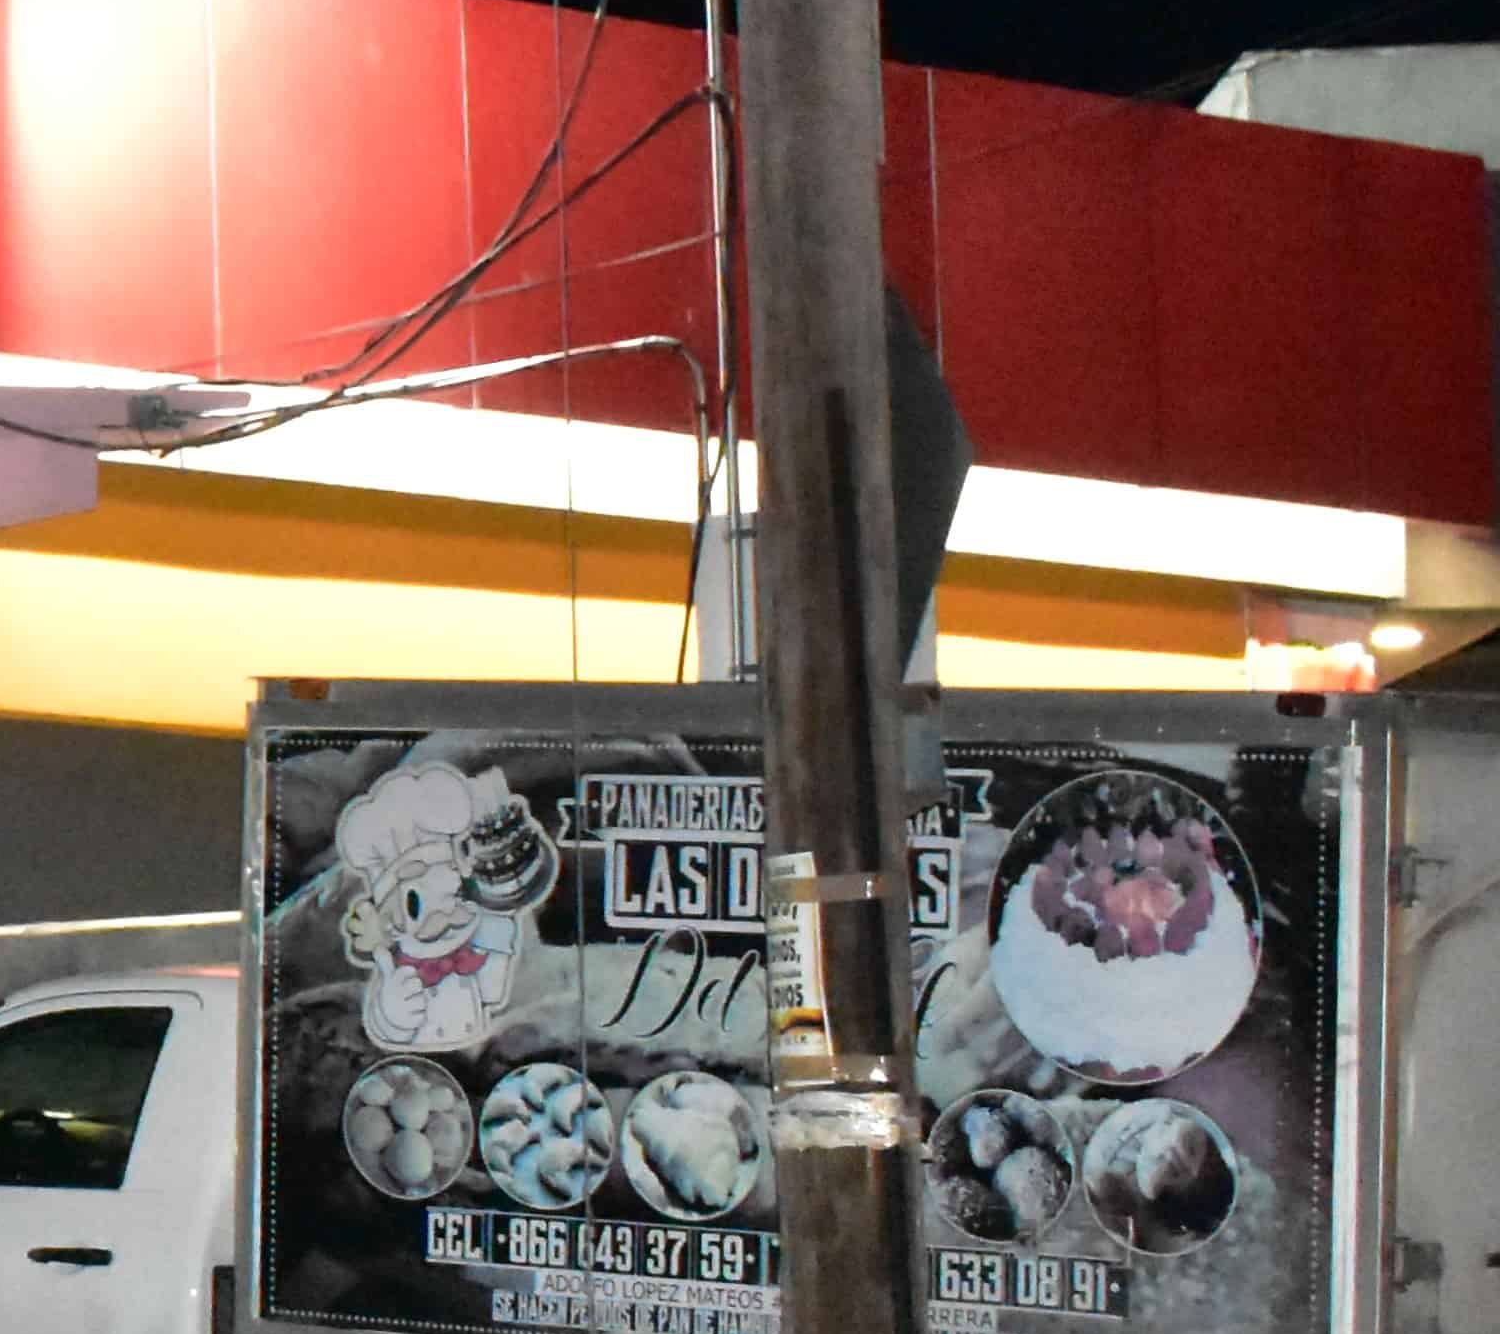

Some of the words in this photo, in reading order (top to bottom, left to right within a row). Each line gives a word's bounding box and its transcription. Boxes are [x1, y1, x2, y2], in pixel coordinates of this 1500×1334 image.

[617, 842, 708, 917] LAS
[426, 1212, 484, 1260] CEL
[508, 1218, 568, 1267] 866
[646, 1227, 688, 1276] 37
[700, 1233, 745, 1281] 59
[939, 1250, 1003, 1303] 633
[1016, 1257, 1063, 1307] 08
[1071, 1260, 1108, 1312] 91
[622, 1280, 680, 1303] LOPEZ
[687, 1286, 765, 1310] MATEOS
[927, 1307, 994, 1330] RRERA
